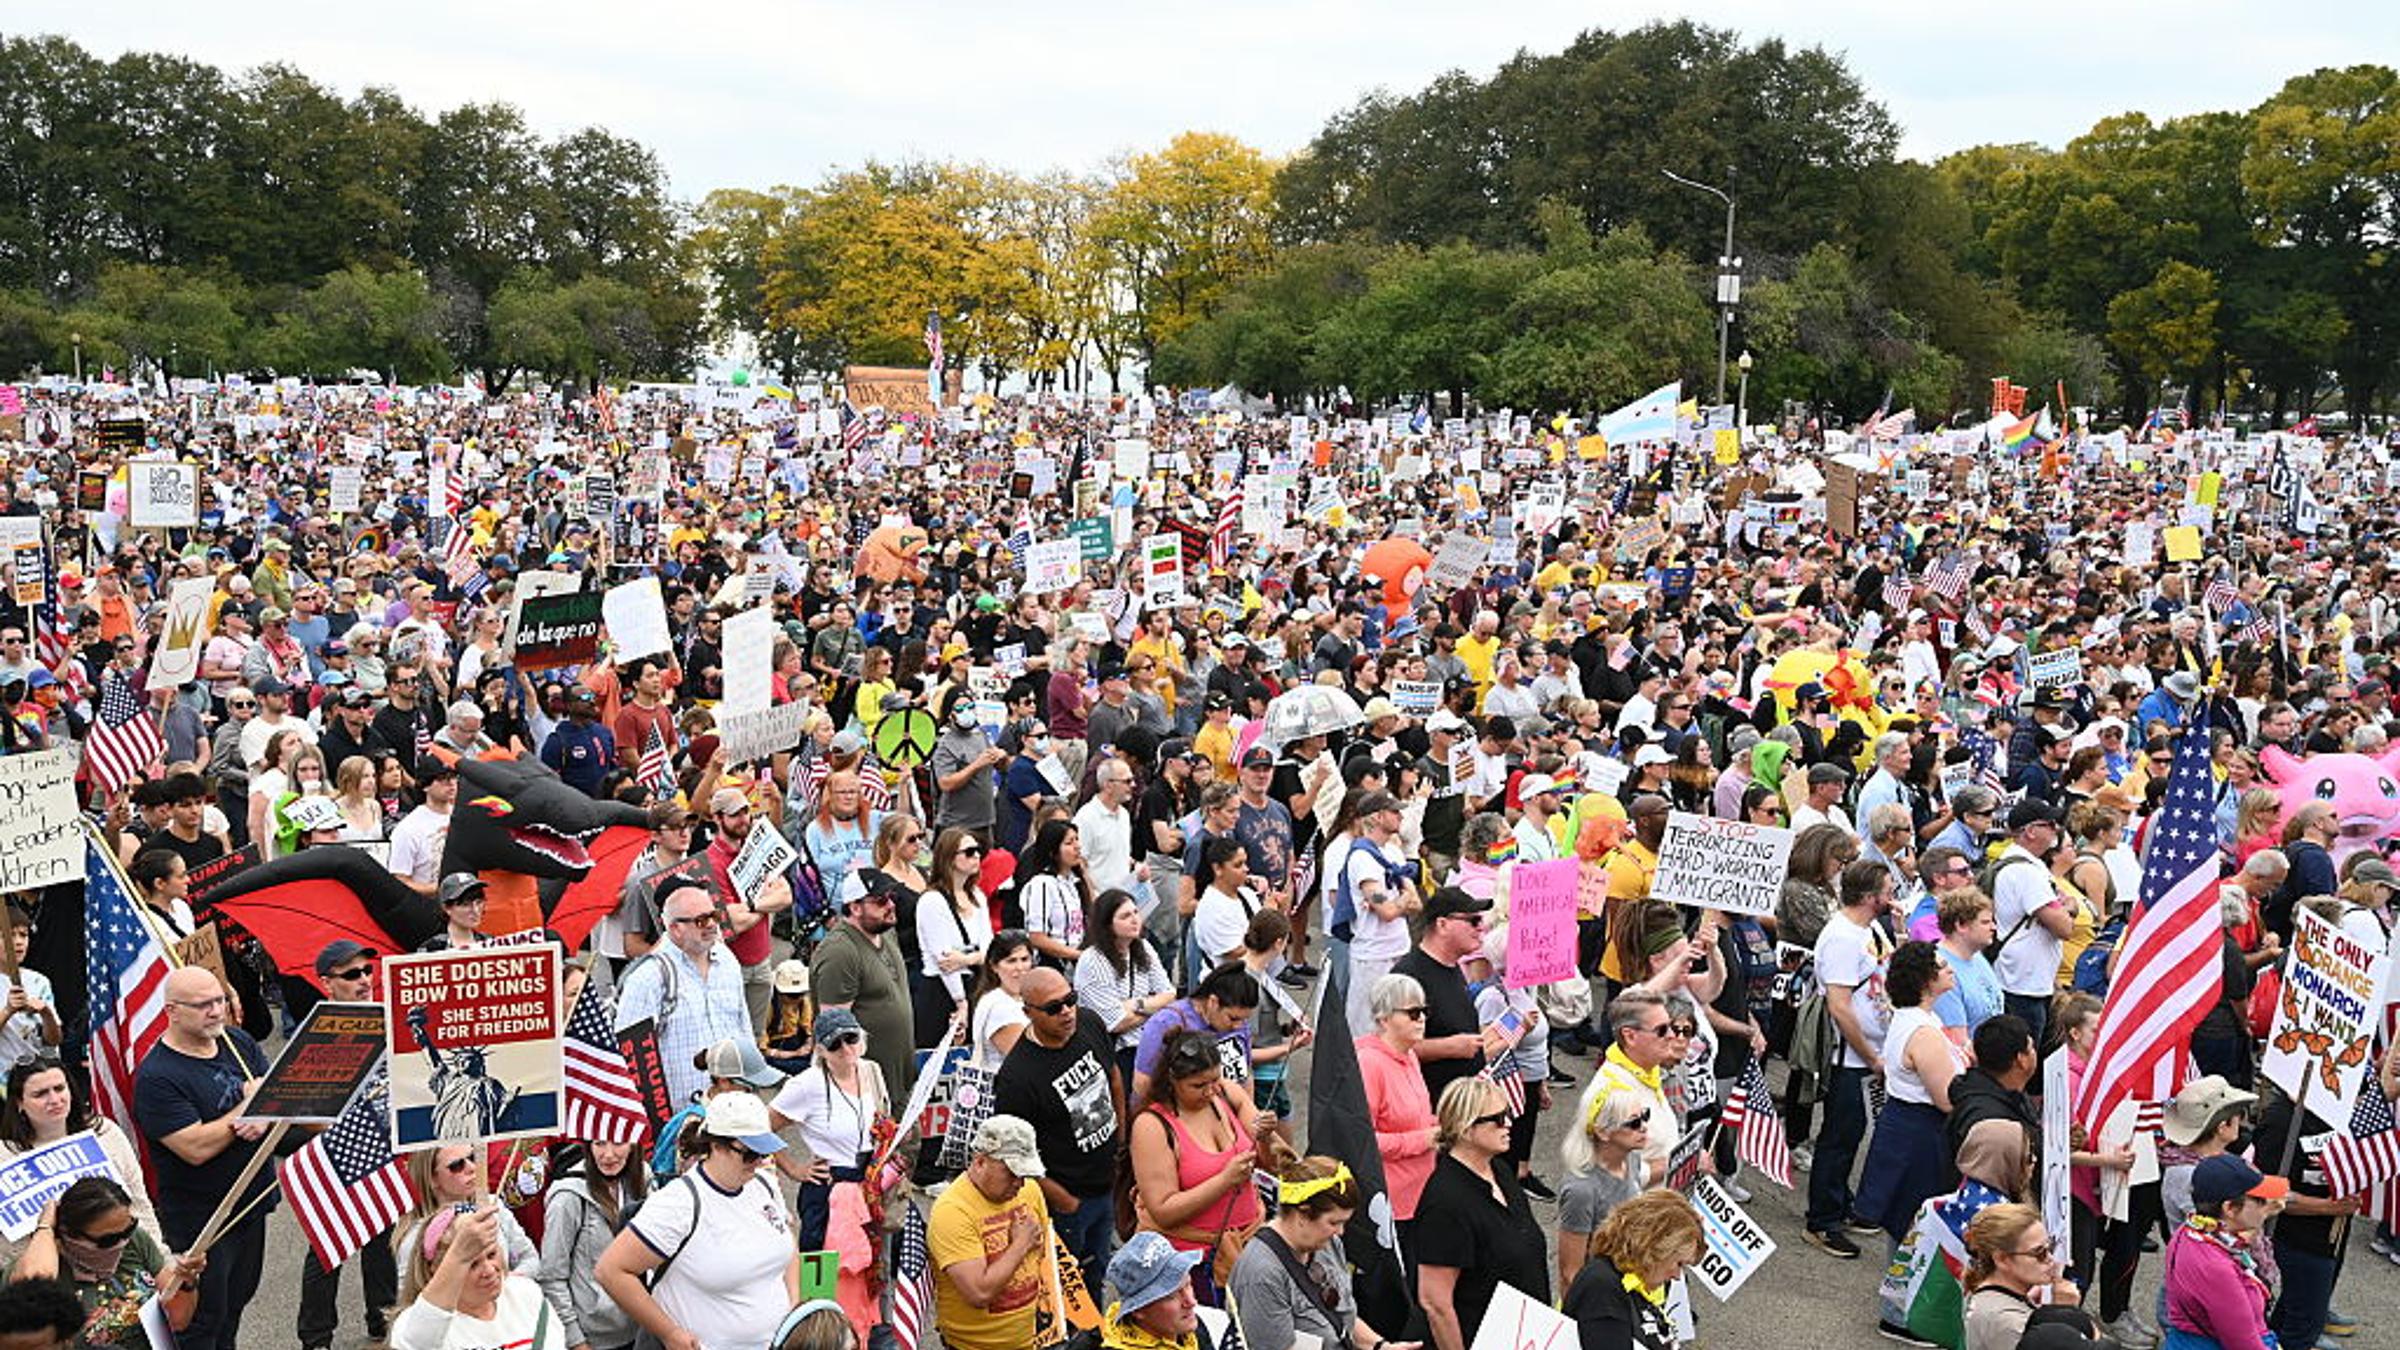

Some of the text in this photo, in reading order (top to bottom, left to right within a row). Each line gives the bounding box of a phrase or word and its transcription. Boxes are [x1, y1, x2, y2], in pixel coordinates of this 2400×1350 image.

[2030, 651, 2062, 667] HANDS
[2034, 668, 2080, 689] CHICAGO
[36, 773, 73, 791] when
[0, 815, 82, 858] Leaders
[1669, 825, 1776, 860] TERRORIZING
[1698, 815, 1758, 840] STOP
[0, 856, 70, 889] ldren
[186, 853, 245, 886] UMP'S
[1659, 844, 1783, 886] HARD-WORKING
[1652, 867, 1776, 911] IMMIGRANTS
[2305, 914, 2375, 974] THE ONLY
[400, 956, 545, 987] SHE DOESN'T
[2310, 947, 2375, 1002] ORANGE
[400, 976, 547, 1006] BOW TO KINGS
[2292, 961, 2366, 1026] MONARCH
[437, 1013, 551, 1040] FOR FREEDOM
[442, 1001, 546, 1024] SHE STANDS
[1051, 1050, 1103, 1101] FUCK
[0, 1158, 41, 1201] ICE
[35, 1141, 92, 1180] OUT!
[1730, 1219, 1767, 1252] OFF
